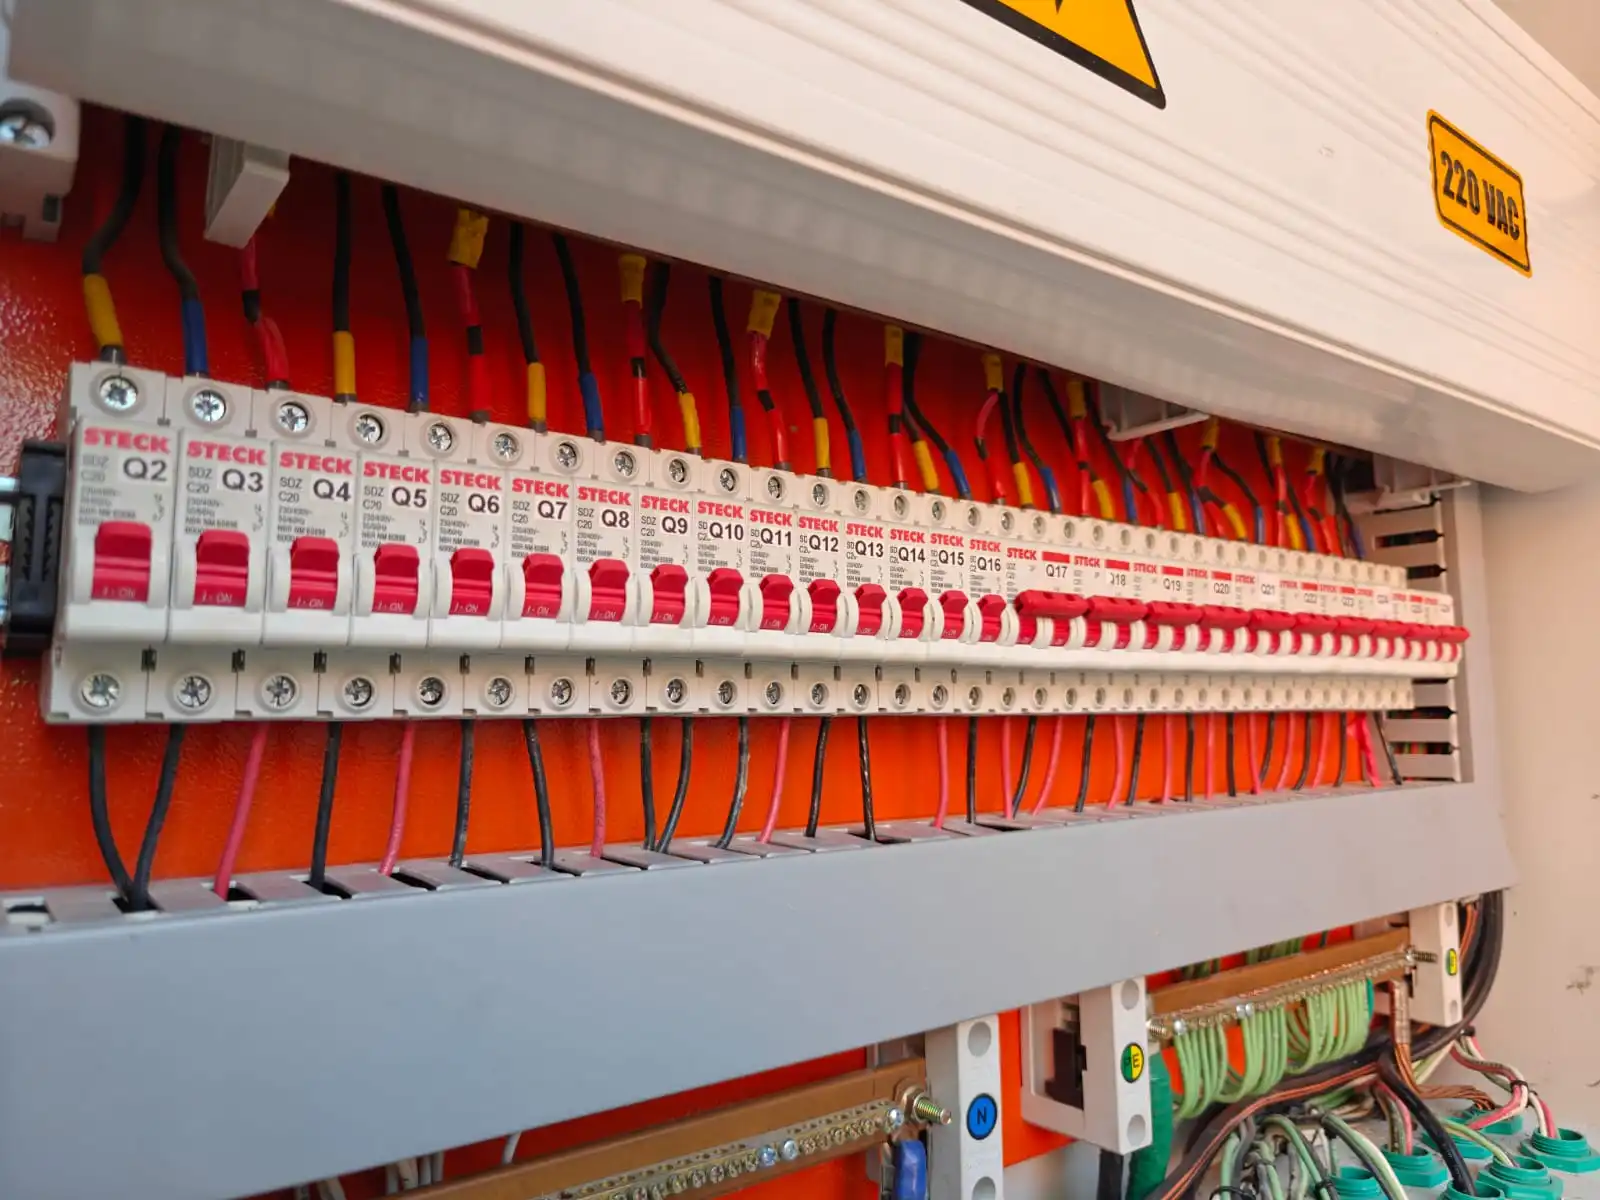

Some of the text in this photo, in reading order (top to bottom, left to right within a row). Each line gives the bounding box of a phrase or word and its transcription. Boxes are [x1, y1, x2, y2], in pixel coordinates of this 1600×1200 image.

[1440, 150, 1521, 241] 220 VAC
[83, 427, 170, 454] STECK
[187, 441, 267, 466] STECK
[123, 457, 167, 482] Q2
[280, 452, 352, 475] STECK
[222, 468, 264, 493] Q3
[363, 461, 431, 484] STECK
[440, 469, 502, 490] STECK
[187, 482, 209, 493] C20
[280, 477, 303, 489] SDZ
[313, 478, 351, 501] Q4
[512, 478, 569, 498] STECK
[279, 491, 299, 503] C20
[364, 485, 384, 498] SDZ
[392, 486, 427, 508] Q5
[440, 493, 459, 504] SDZ
[577, 486, 632, 506] STECK
[362, 499, 382, 510] C20
[468, 493, 500, 514] Q6
[512, 501, 530, 511] SDZ
[537, 500, 568, 519] Q7
[640, 495, 690, 513] STECK
[697, 501, 744, 519] STECK
[439, 507, 457, 517] C20
[511, 514, 528, 524] C20
[577, 507, 594, 517] SDZ
[601, 509, 630, 528] Q8
[750, 509, 792, 526] STECK
[577, 520, 592, 530] C20
[640, 516, 656, 526] SDZ
[662, 516, 688, 534] Q9
[798, 516, 838, 532] STECK
[640, 528, 655, 537] C20
[709, 522, 744, 540] Q10
[760, 528, 792, 546] Q11
[846, 523, 884, 539] STECK
[889, 528, 925, 543] STECK
[809, 535, 839, 552] Q12
[930, 533, 964, 547] STECK
[969, 539, 1001, 552] STECK
[855, 540, 884, 558] Q13
[898, 547, 926, 562] Q14
[1006, 547, 1037, 560] STECK
[938, 550, 965, 566] Q15
[977, 556, 1001, 572] Q16
[1073, 556, 1100, 568] STECK
[1046, 564, 1068, 578] Q17
[1133, 562, 1157, 574] STECK
[1163, 577, 1181, 591] Q19
[1213, 583, 1230, 594] Q20
[1260, 584, 1275, 595] Q21
[977, 1106, 987, 1124] N
